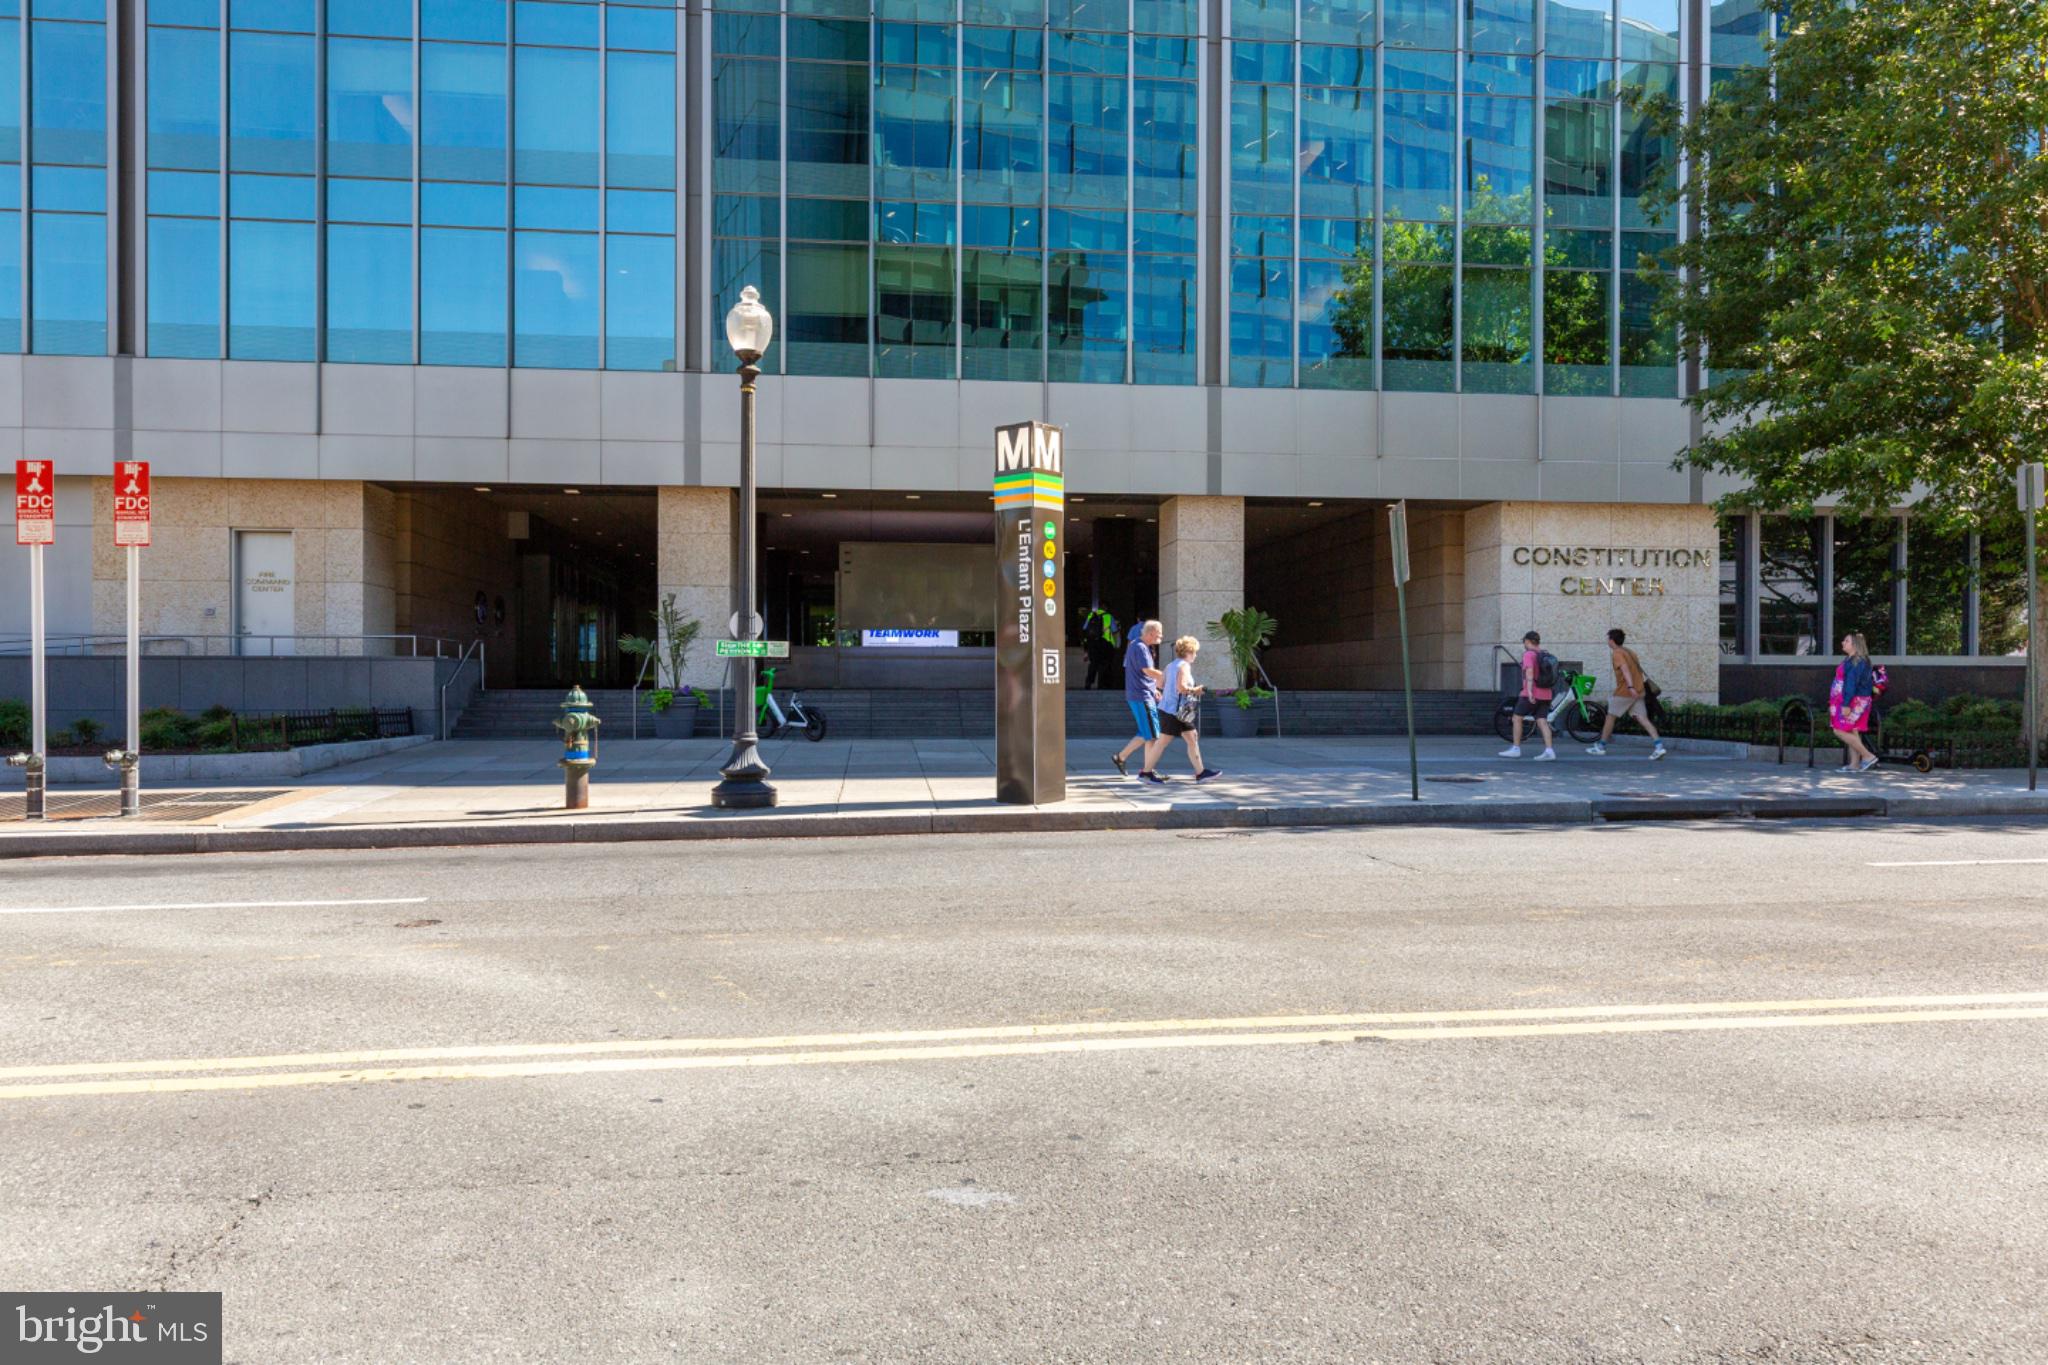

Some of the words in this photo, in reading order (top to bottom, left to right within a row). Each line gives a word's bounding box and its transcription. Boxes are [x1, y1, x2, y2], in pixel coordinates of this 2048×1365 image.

[997, 427, 1029, 472] M
[1034, 427, 1060, 472] M
[17, 495, 52, 509] FDC
[115, 496, 149, 510] FDC
[1018, 519, 1032, 591] L'Enfant
[1513, 547, 1711, 567] CONSTITUTION
[1560, 576, 1664, 596] CENTER
[1019, 597, 1032, 643] Plaza
[869, 629, 940, 638] TEAMWORK
[1046, 656, 1057, 676] B
